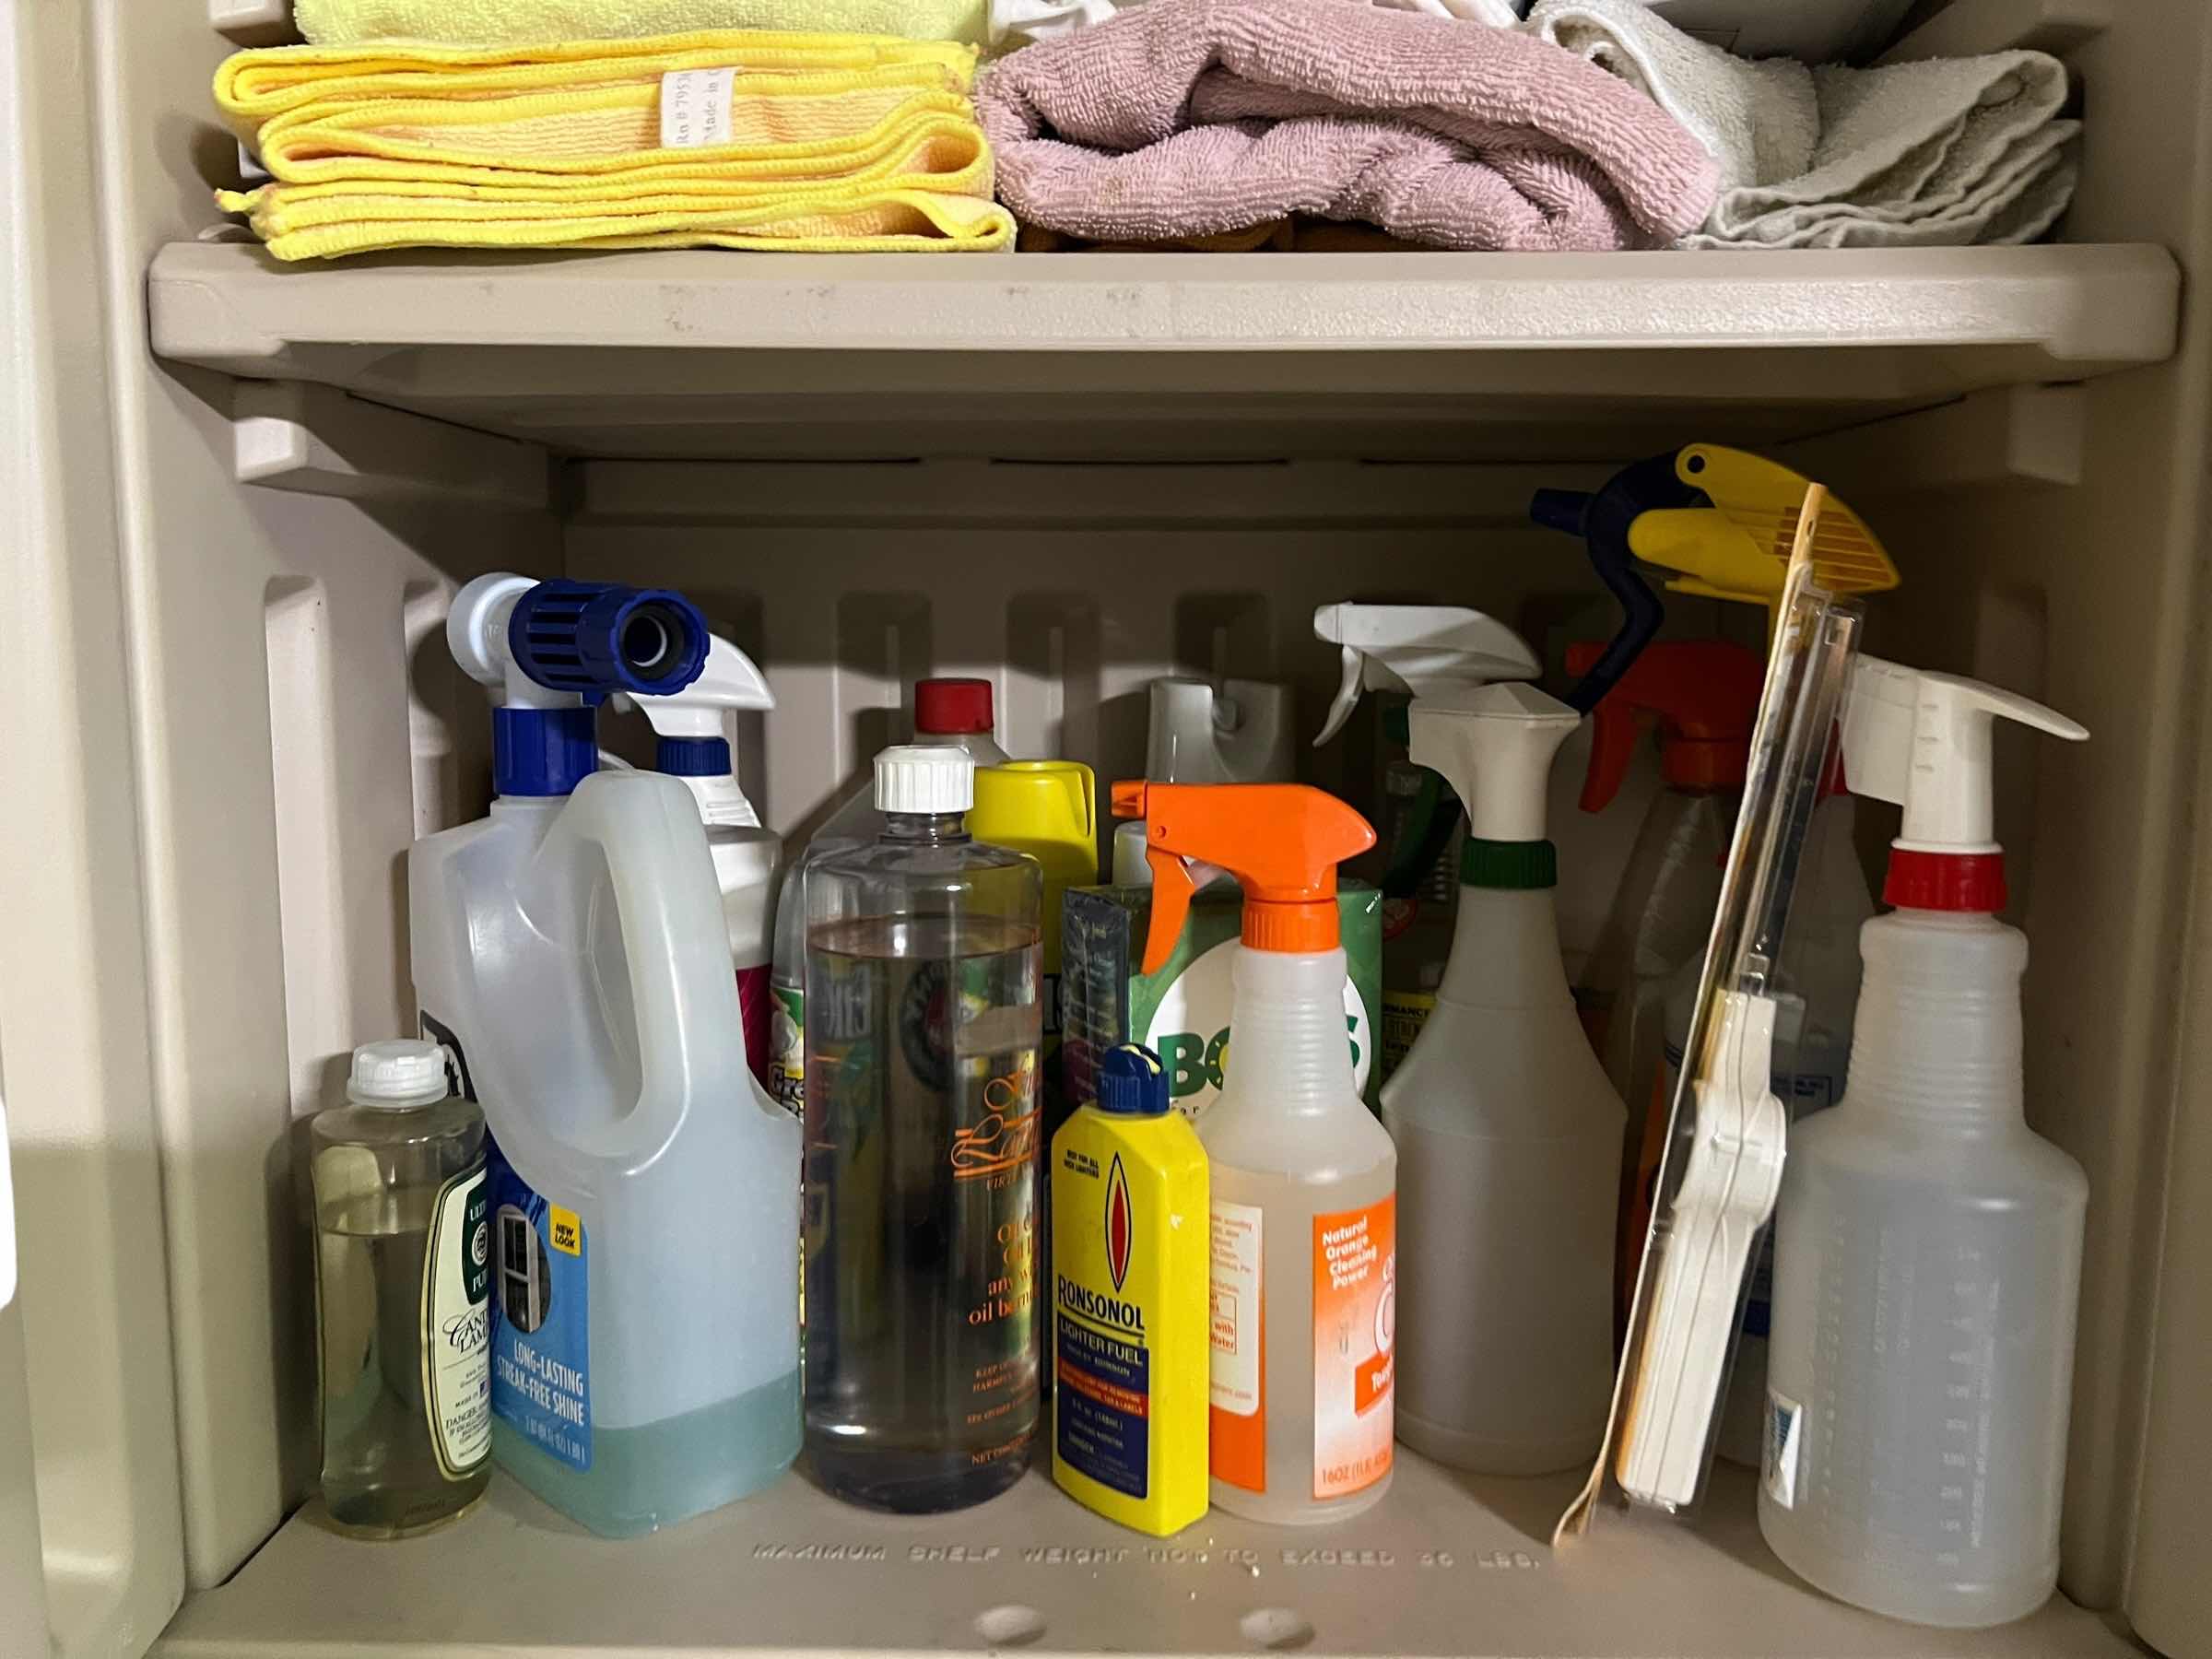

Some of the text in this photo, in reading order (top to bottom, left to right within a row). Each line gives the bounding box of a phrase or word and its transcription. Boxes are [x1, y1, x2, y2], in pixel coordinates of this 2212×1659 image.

[555, 1233, 576, 1249] LOOK
[556, 1223, 574, 1238] NEW
[1322, 1214, 1368, 1247] Natural
[1325, 1233, 1369, 1262] Orange
[1330, 1243, 1377, 1277] Cleaning
[1333, 1264, 1368, 1291] Power
[969, 1300, 993, 1325] oil
[1058, 1273, 1146, 1330] RONSONOL
[1061, 1318, 1144, 1366] LIGHTER FUEL
[513, 1338, 583, 1397] LONG-LASTING
[497, 1355, 551, 1410] STREAK-FREE
[553, 1390, 585, 1428] SHINE
[752, 1543, 887, 1563] MAXIMUM
[906, 1544, 1001, 1564] SHELF
[1023, 1546, 1129, 1565] WEIGHT
[1224, 1548, 1260, 1565] TO
